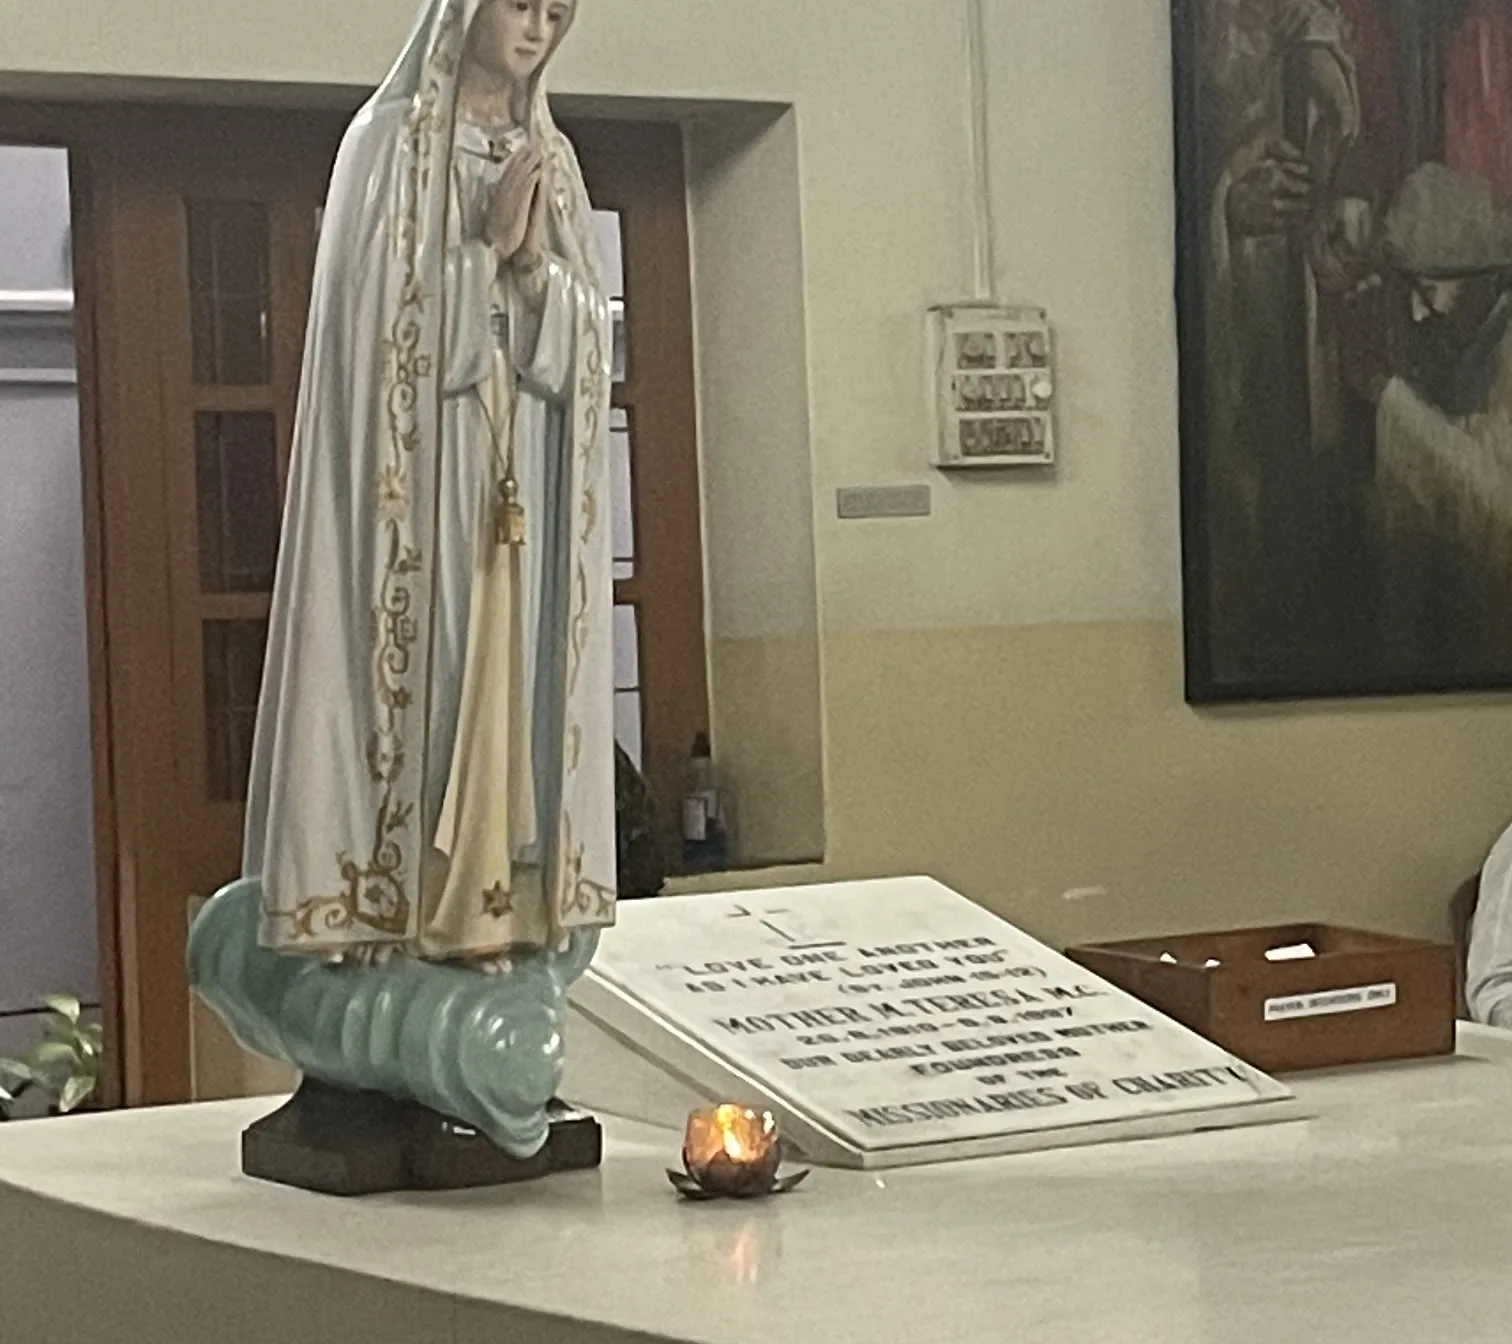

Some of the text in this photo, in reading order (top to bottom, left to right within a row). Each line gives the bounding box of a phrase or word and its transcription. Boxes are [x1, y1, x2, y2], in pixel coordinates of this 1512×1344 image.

[780, 951, 848, 966] ONE
[858, 937, 997, 957] ANOTHER
[685, 981, 726, 993] AS
[732, 978, 748, 989] I
[750, 970, 832, 986] HAVE
[838, 959, 940, 978] LOVED
[899, 975, 967, 988] JOHN
[712, 1006, 873, 1035] MOTHER
[1041, 984, 1110, 1001] M.C.
[779, 1020, 1152, 1070] OUR DEARLY BELOVED MOTHER
[909, 1046, 1082, 1076] FOUNDRESS
[976, 1067, 1068, 1085] OF THE
[843, 1066, 1248, 1127] MISSIONARIES OF CHARITY
